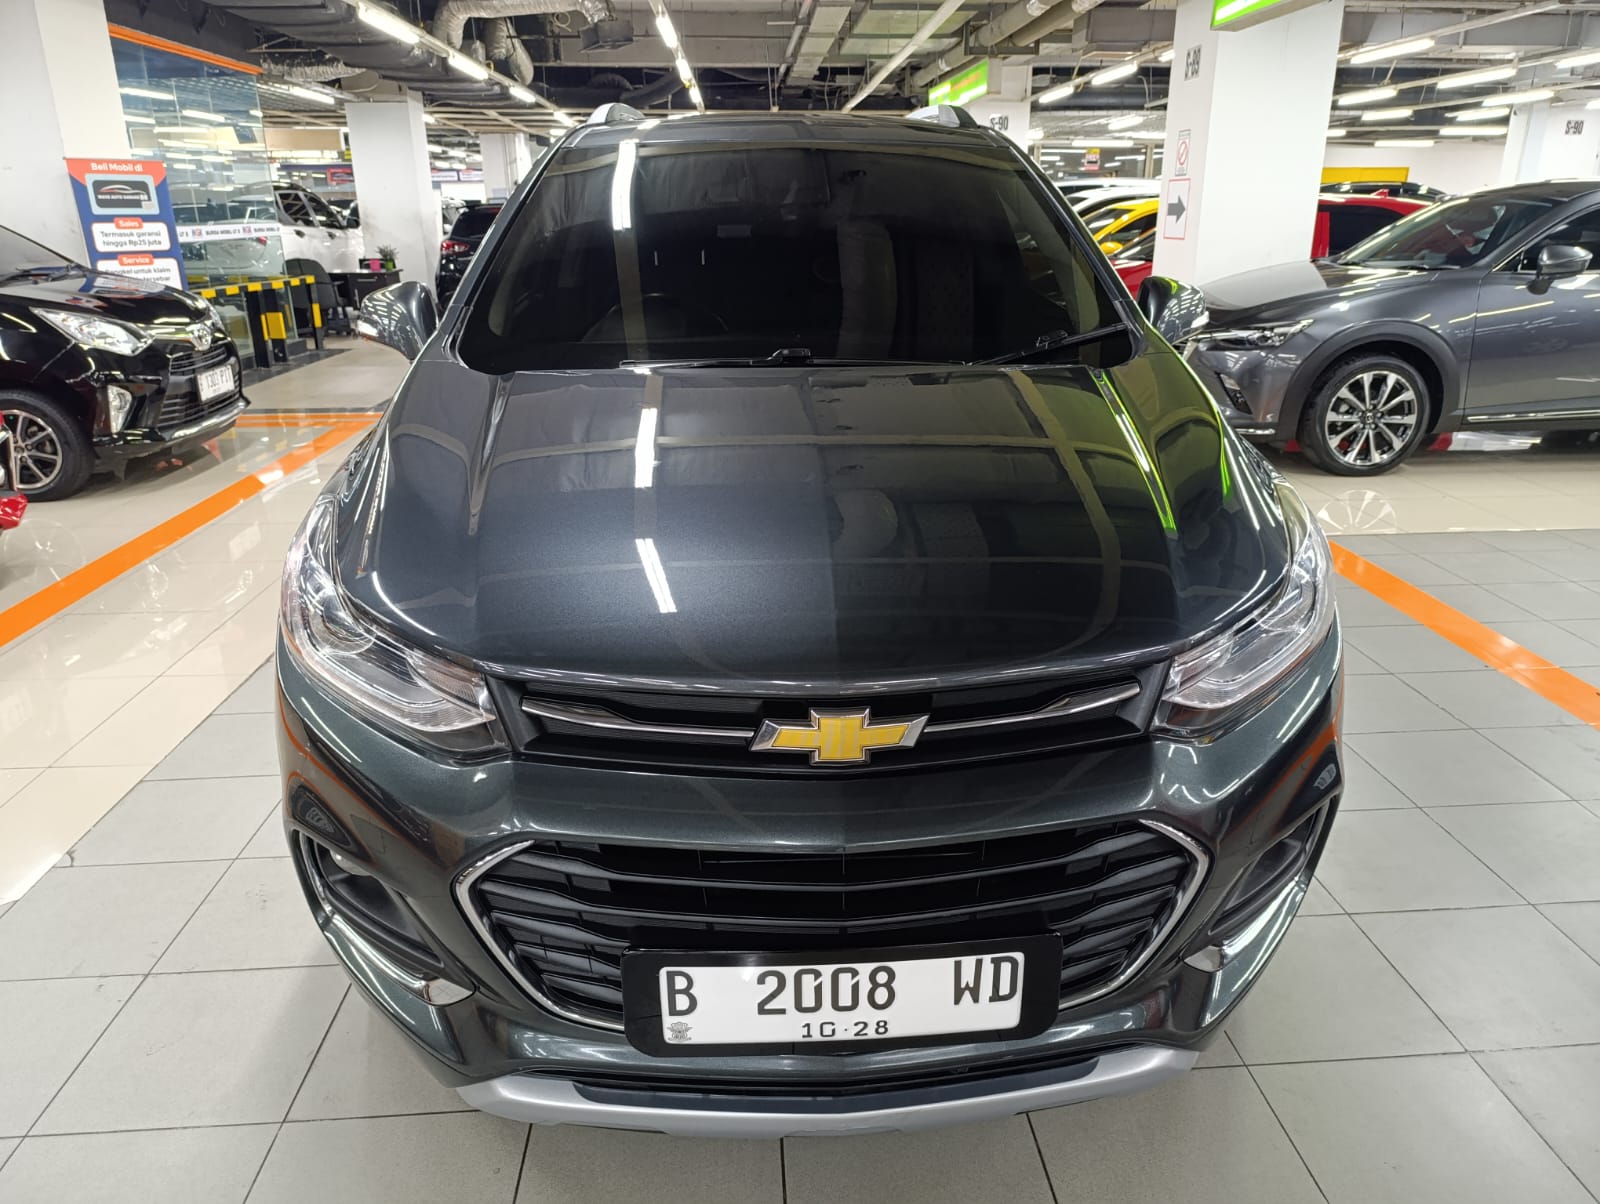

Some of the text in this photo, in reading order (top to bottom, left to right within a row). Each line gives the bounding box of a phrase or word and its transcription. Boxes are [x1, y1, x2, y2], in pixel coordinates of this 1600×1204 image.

[990, 116, 1009, 131] S-90
[1564, 120, 1584, 135] S-90
[91, 163, 143, 172] Beli Mobil di
[118, 220, 140, 228] Sales
[136, 230, 161, 239] garansi
[102, 239, 162, 249] hingga Rp25 juta
[122, 256, 150, 264] Service
[153, 265, 171, 273] klaim
[666, 956, 1019, 1017] B 2008 WD
